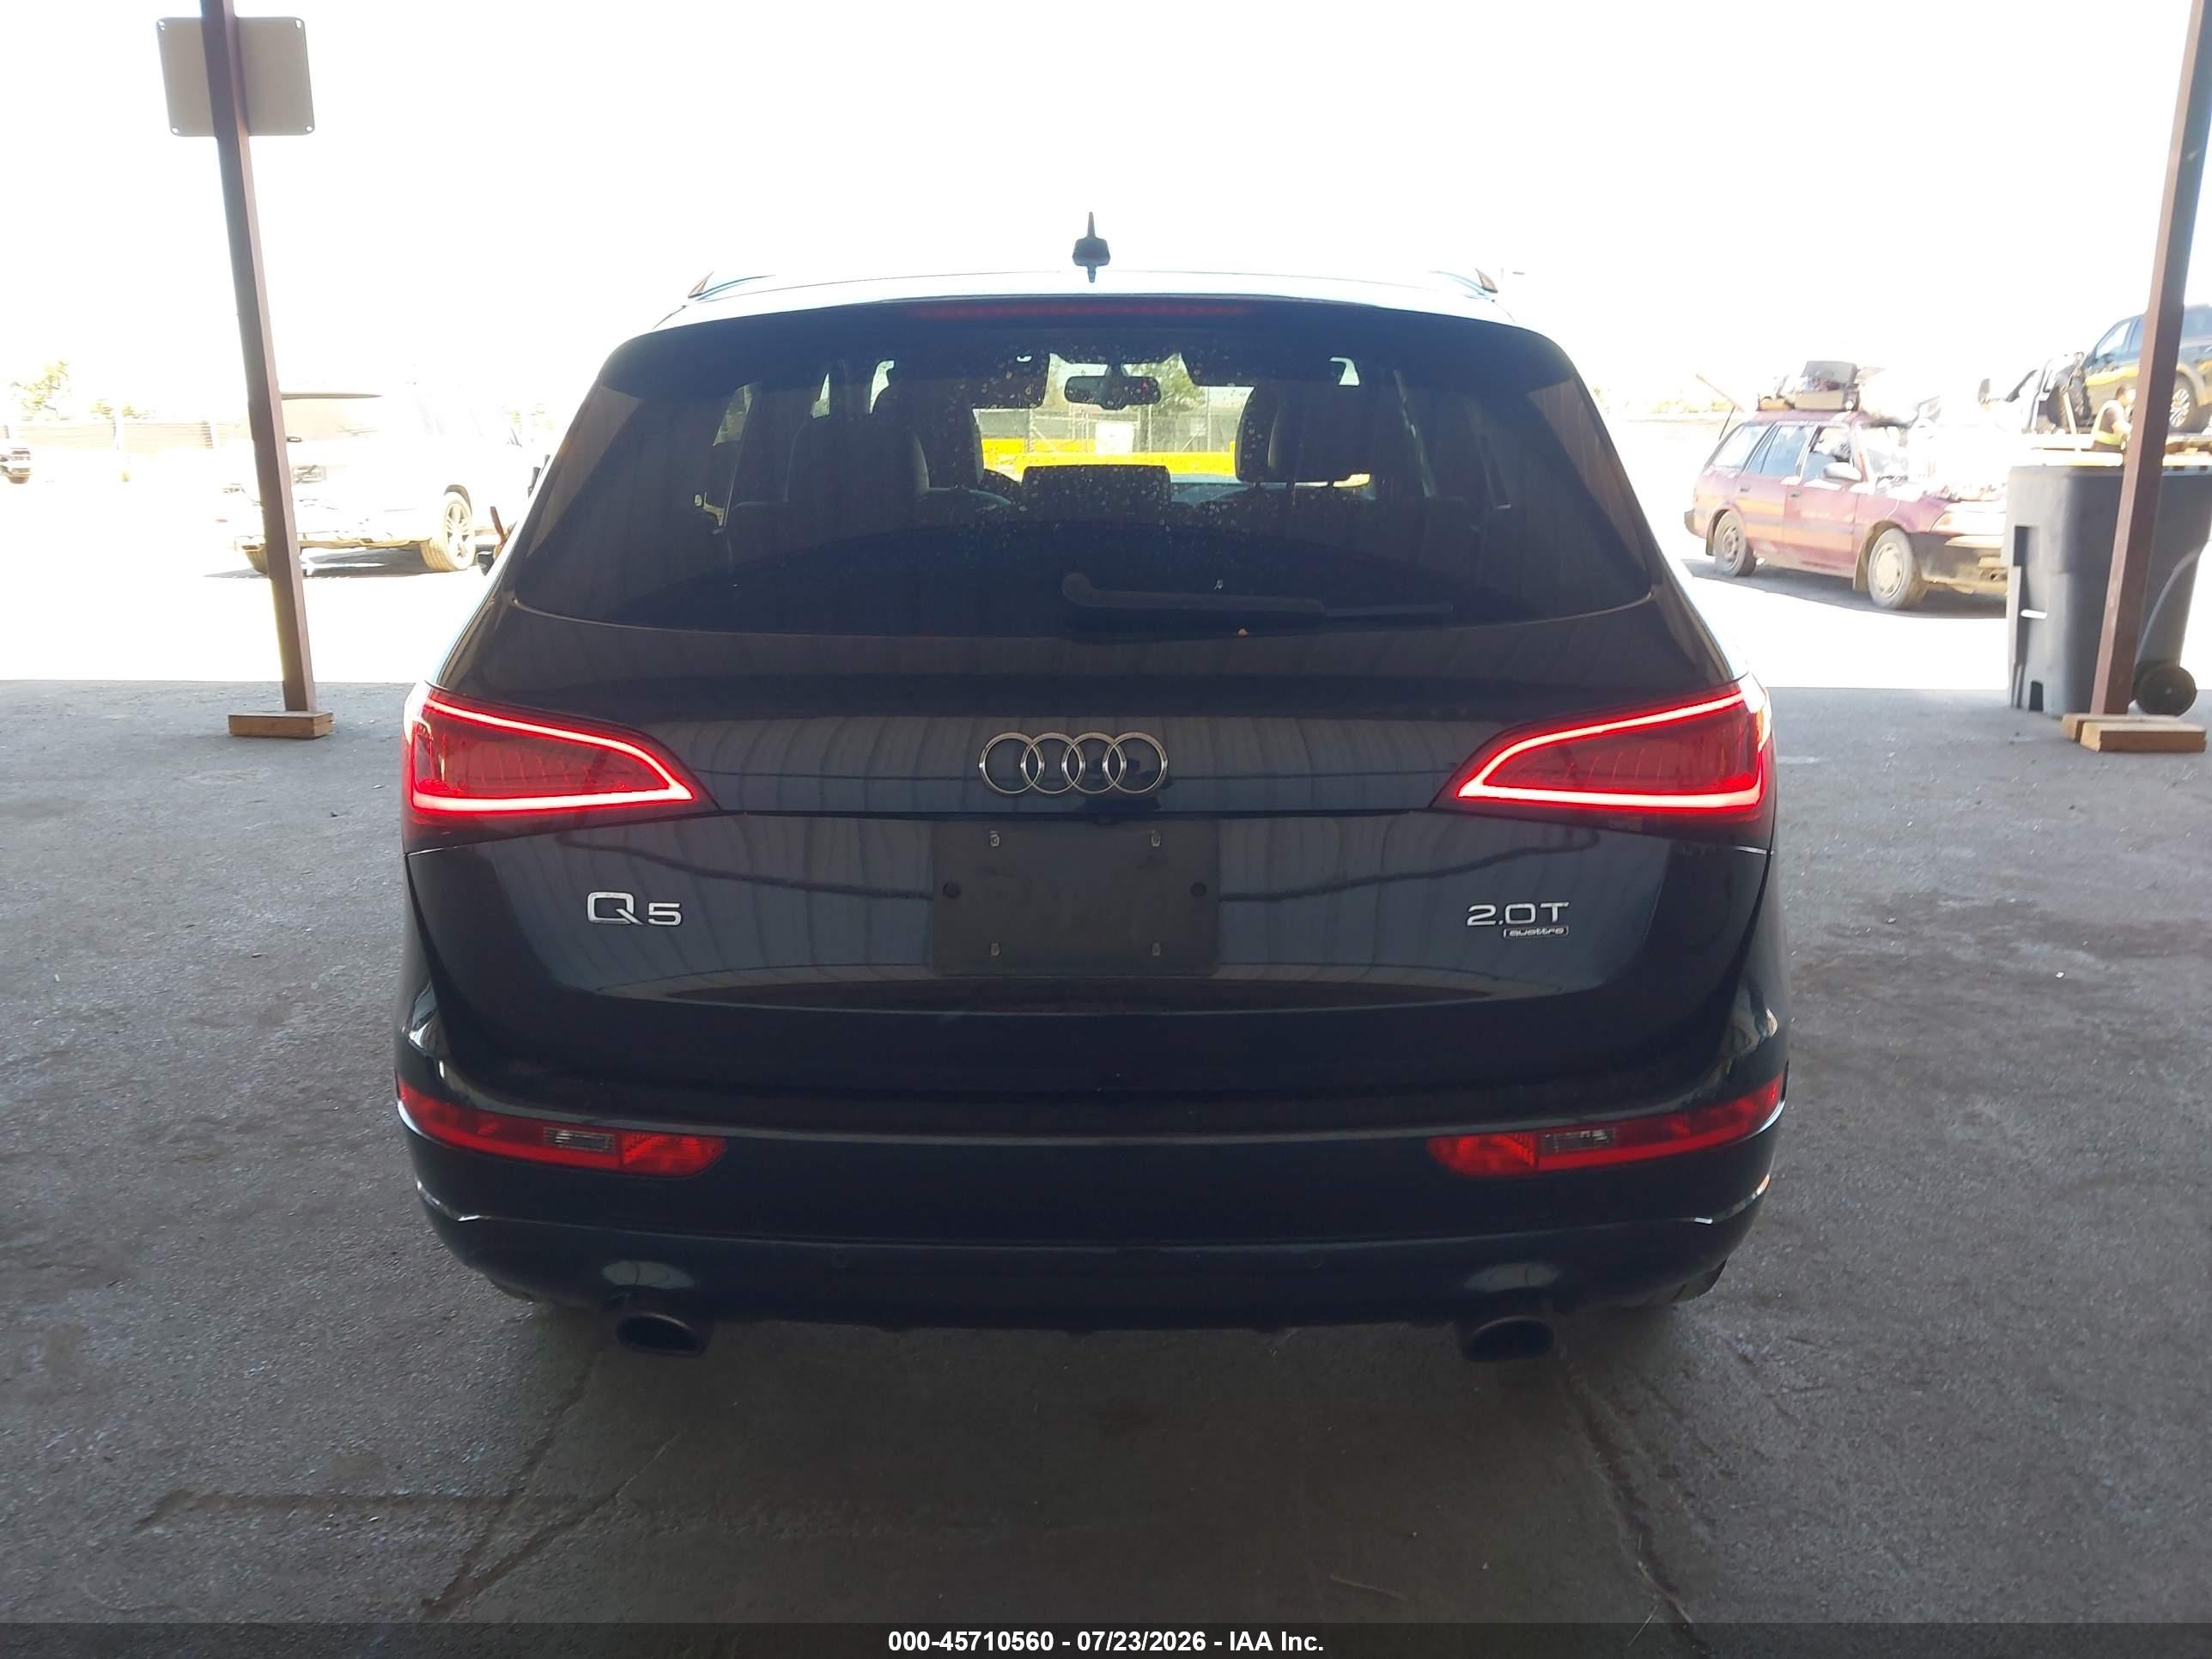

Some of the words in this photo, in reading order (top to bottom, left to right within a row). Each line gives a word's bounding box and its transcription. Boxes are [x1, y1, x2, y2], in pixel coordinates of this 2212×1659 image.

[587, 891, 683, 926] Q5
[1467, 902, 1569, 927] 2.0T
[1509, 927, 1565, 938] quattro
